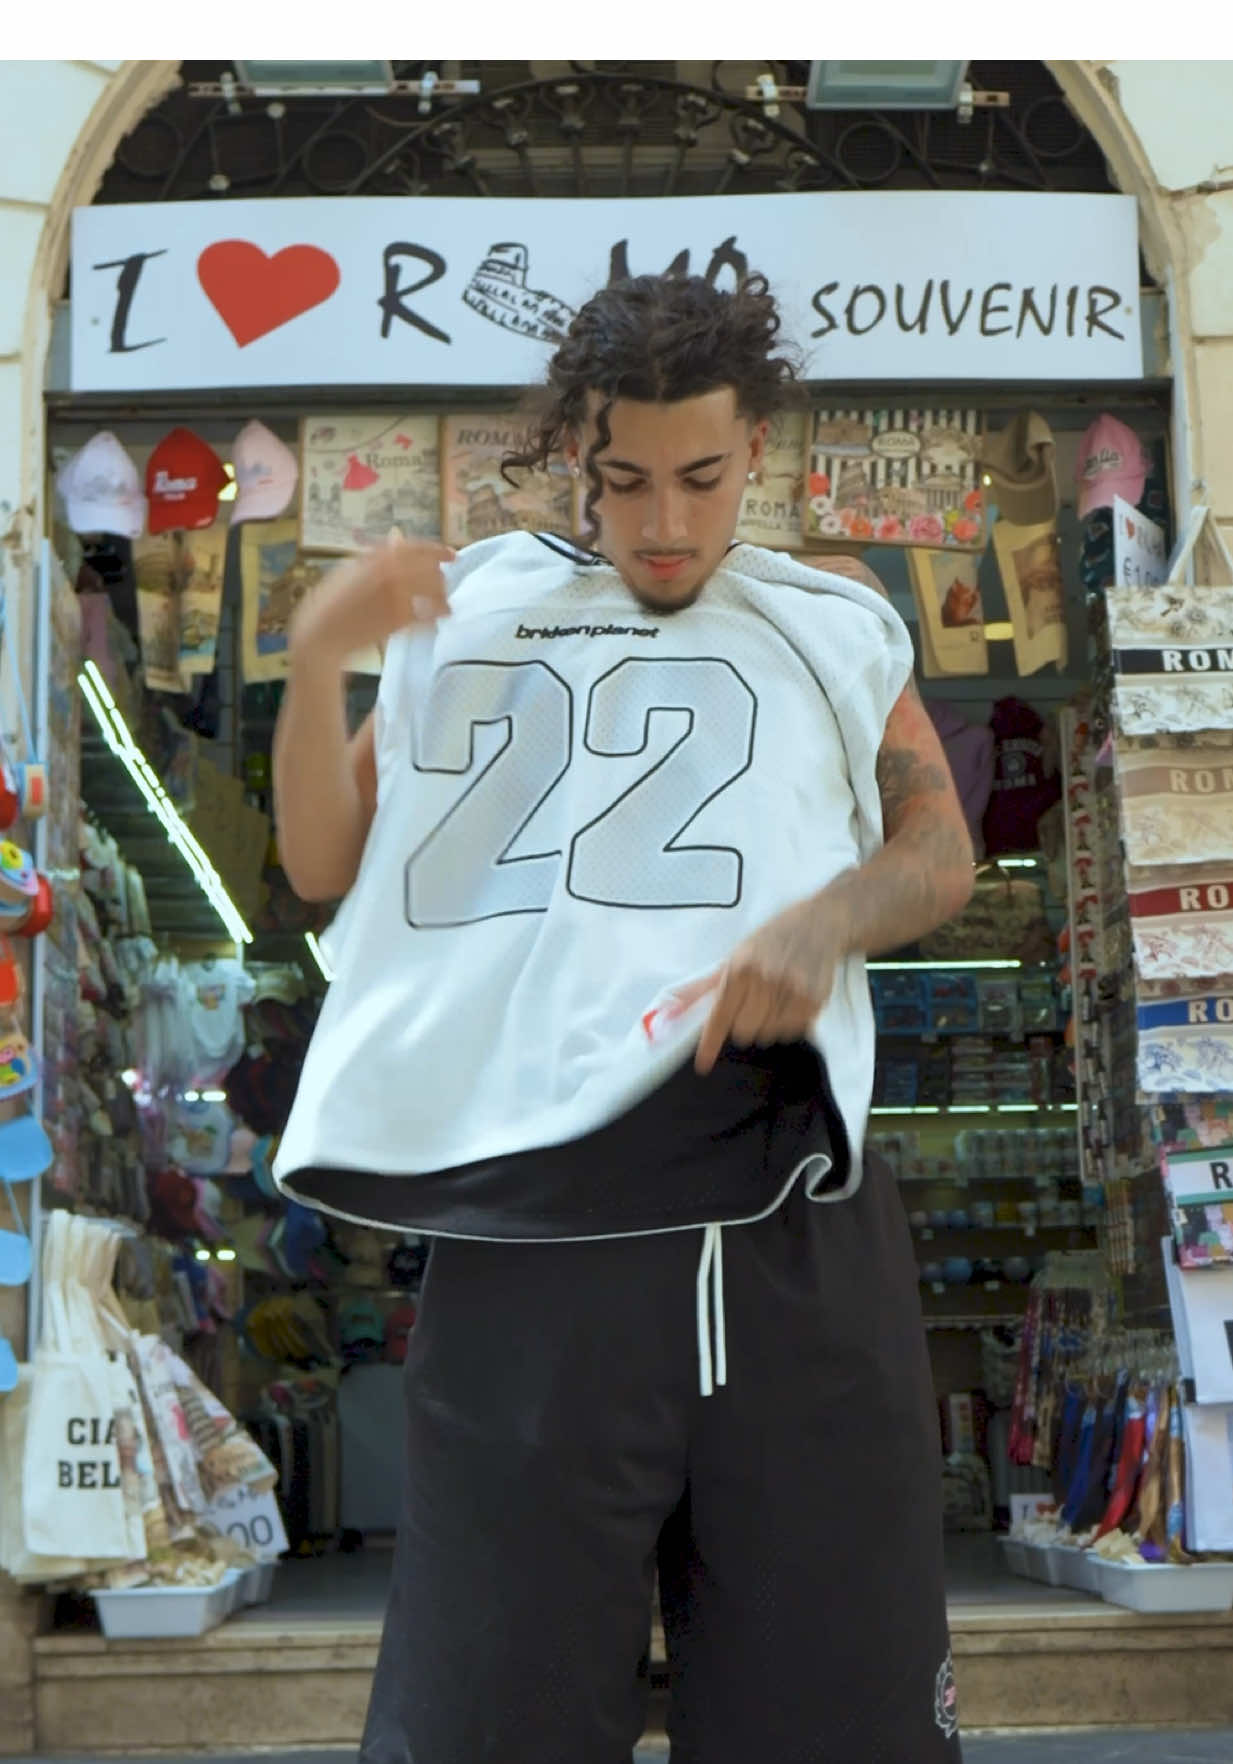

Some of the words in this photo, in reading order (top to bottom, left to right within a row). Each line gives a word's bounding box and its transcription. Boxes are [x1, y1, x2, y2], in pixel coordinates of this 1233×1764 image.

[92, 249, 168, 353] I
[810, 279, 1126, 341] SOUVENIR
[746, 499, 800, 521] ROMA
[403, 656, 758, 930] 22
[1178, 884, 1230, 912] RO
[1210, 1161, 1233, 1190] R
